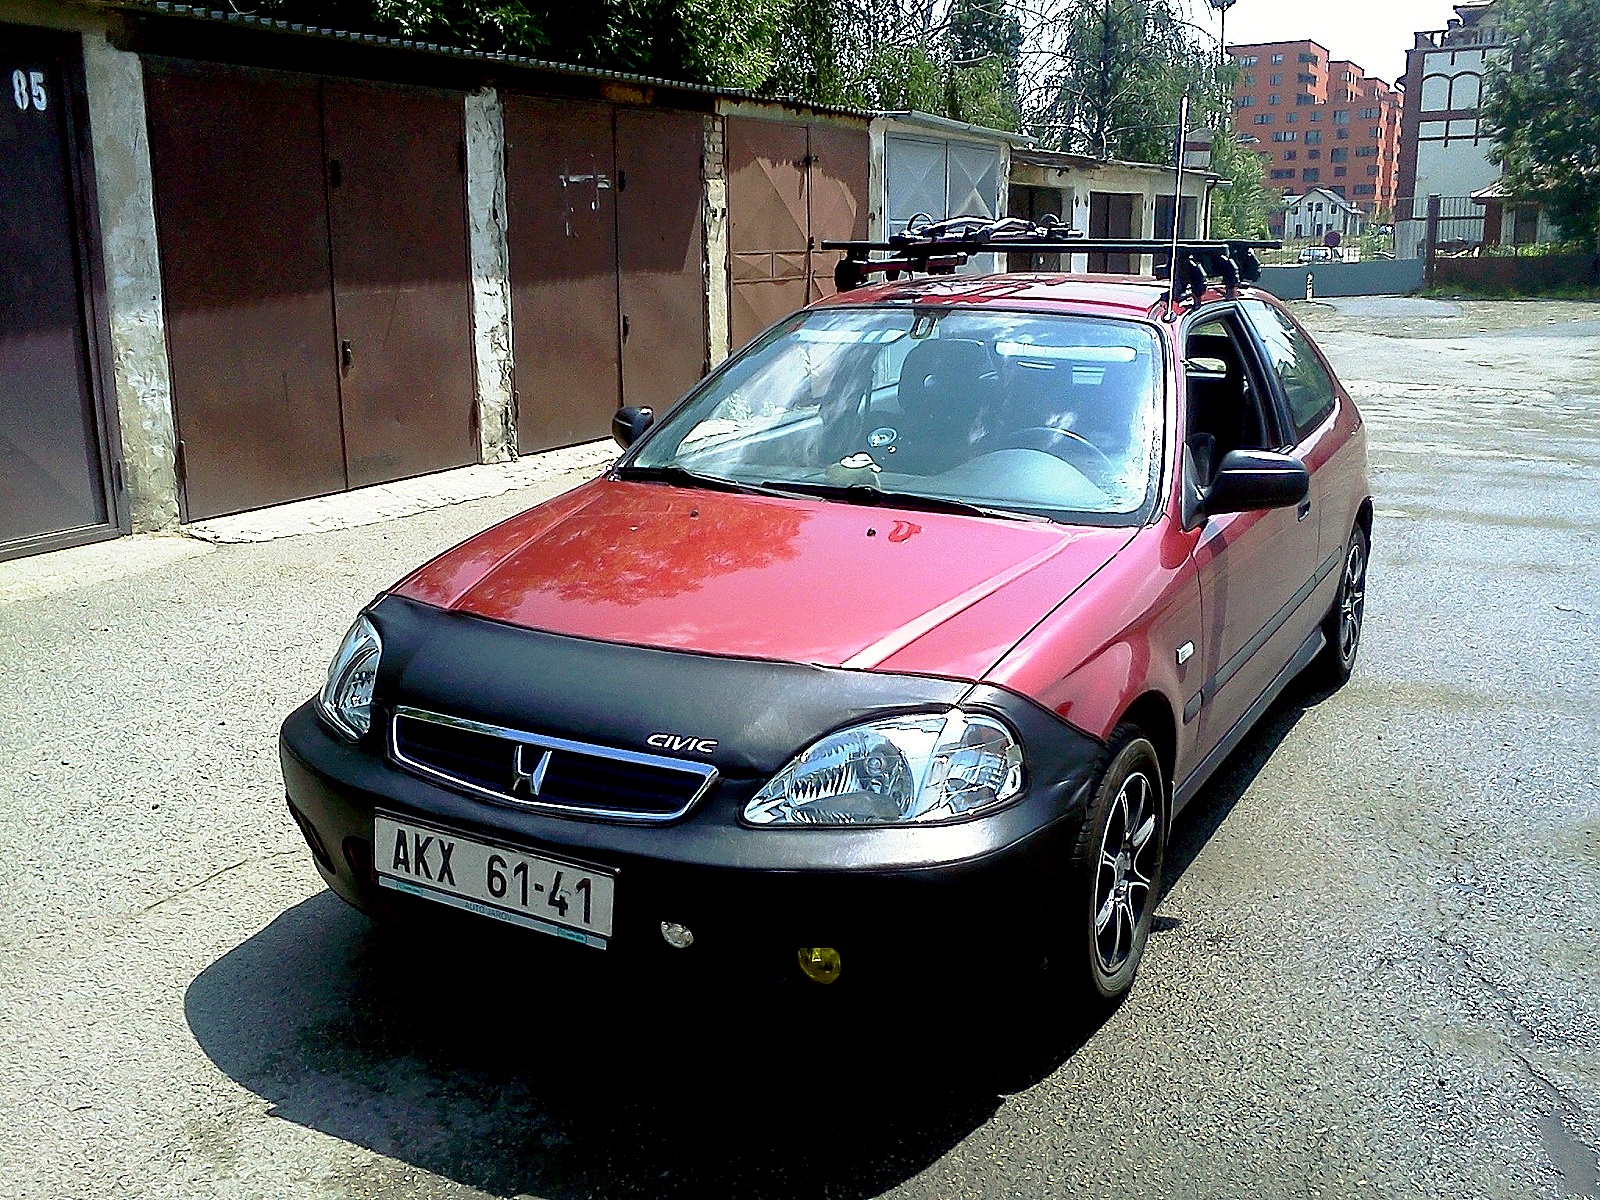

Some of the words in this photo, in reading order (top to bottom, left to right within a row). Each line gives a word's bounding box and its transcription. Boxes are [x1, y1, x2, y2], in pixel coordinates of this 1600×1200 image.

[12, 69, 47, 111] 85
[646, 733, 718, 754] CIVIC
[392, 828, 456, 886] AKX
[487, 854, 592, 924] 61-41
[465, 902, 485, 914] AUTO
